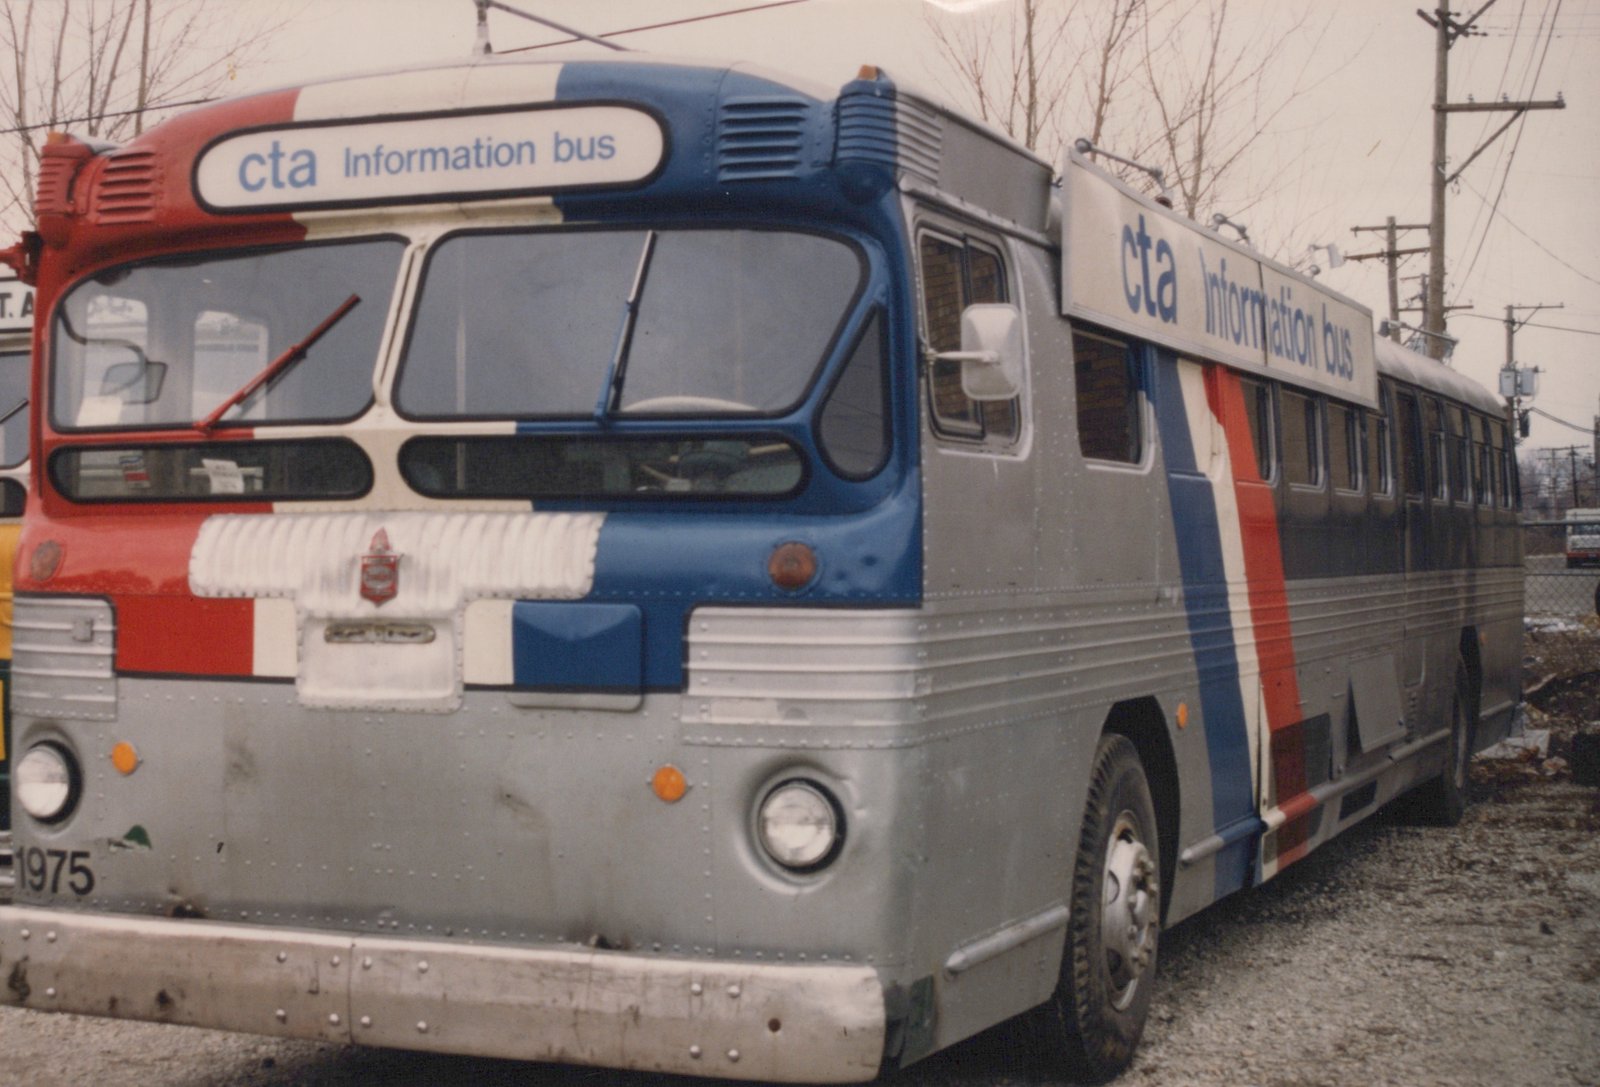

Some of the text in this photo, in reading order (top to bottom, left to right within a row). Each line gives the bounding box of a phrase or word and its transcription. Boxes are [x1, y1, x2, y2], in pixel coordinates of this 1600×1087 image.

[238, 131, 616, 192] cta Information bus
[1121, 213, 1354, 382] cta Information bus
[16, 845, 95, 895] 1975
